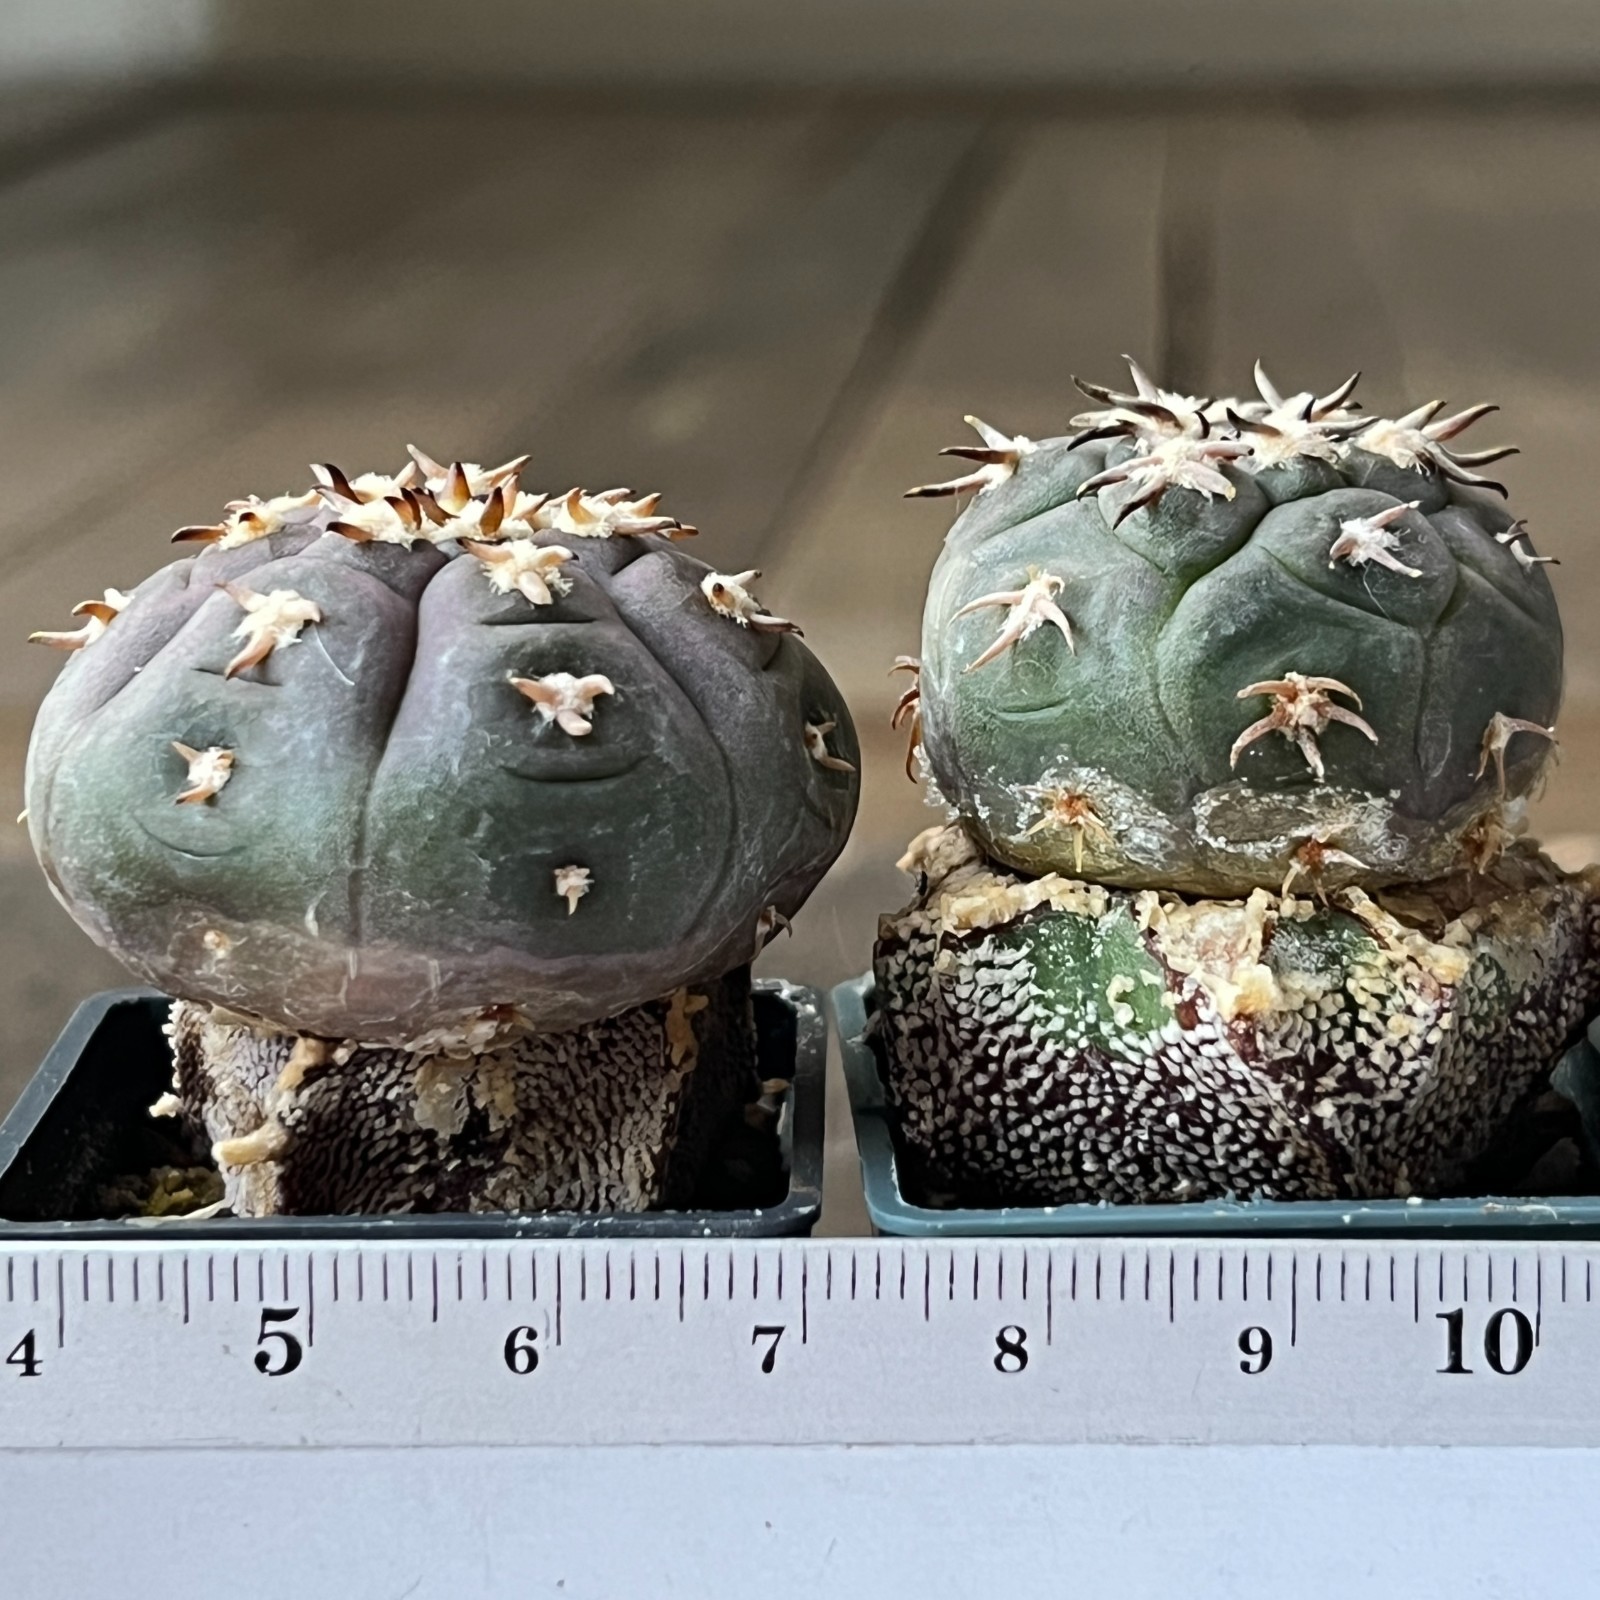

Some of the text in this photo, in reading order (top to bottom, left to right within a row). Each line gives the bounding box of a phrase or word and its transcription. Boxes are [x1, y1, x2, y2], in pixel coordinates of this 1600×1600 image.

[5, 1307, 1534, 1377] 4 5 6 7 8 9 10
